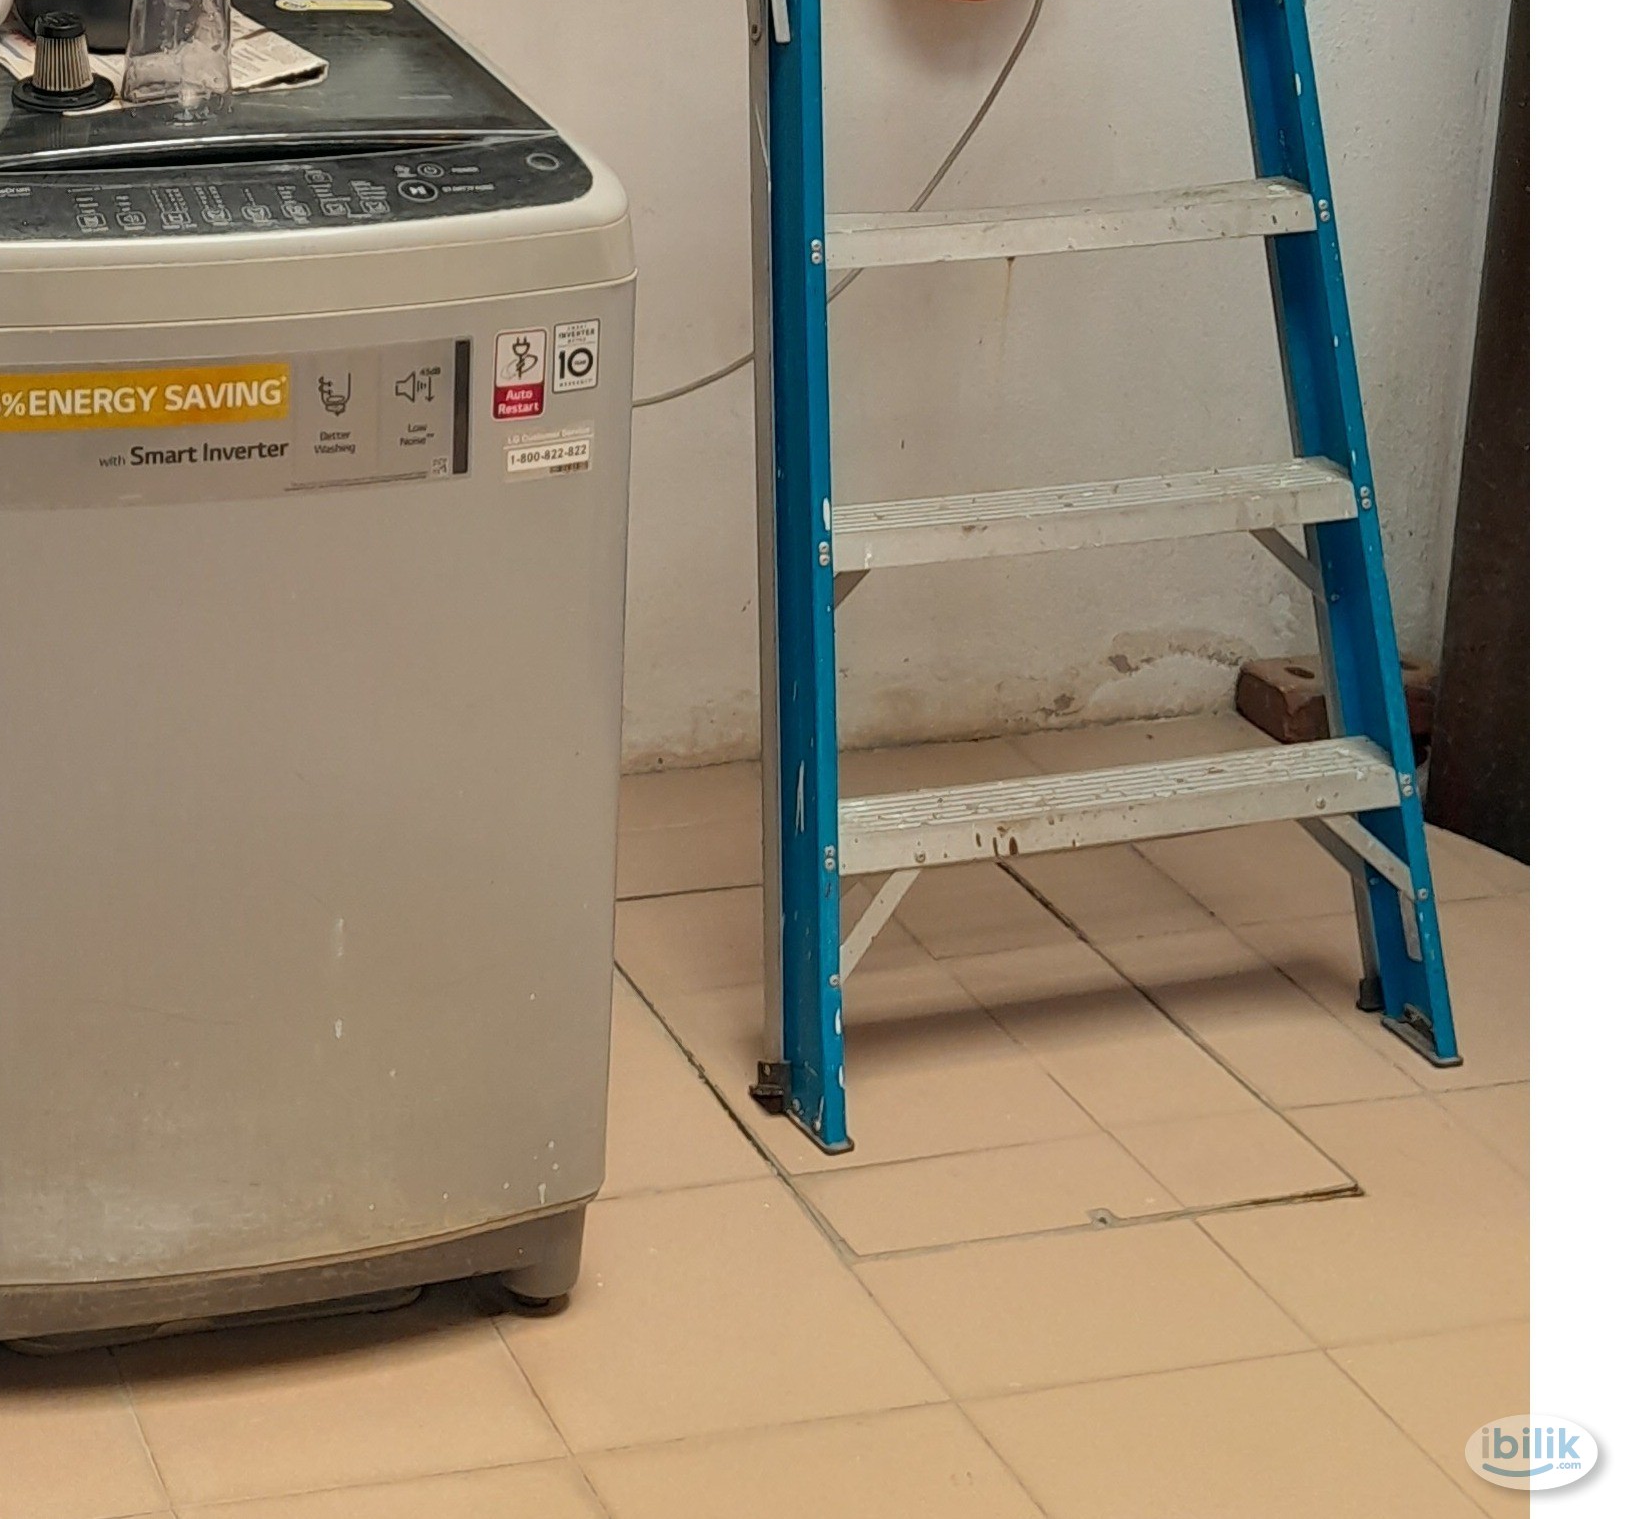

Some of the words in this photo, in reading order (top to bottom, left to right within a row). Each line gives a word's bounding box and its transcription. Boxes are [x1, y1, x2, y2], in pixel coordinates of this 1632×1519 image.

[559, 348, 594, 379] 10
[506, 390, 533, 401] Auto
[498, 402, 539, 415] Restart
[99, 455, 126, 467] with
[130, 446, 197, 466] Smart
[203, 442, 289, 462] Inverter
[511, 444, 587, 465] 1-800-822-822
